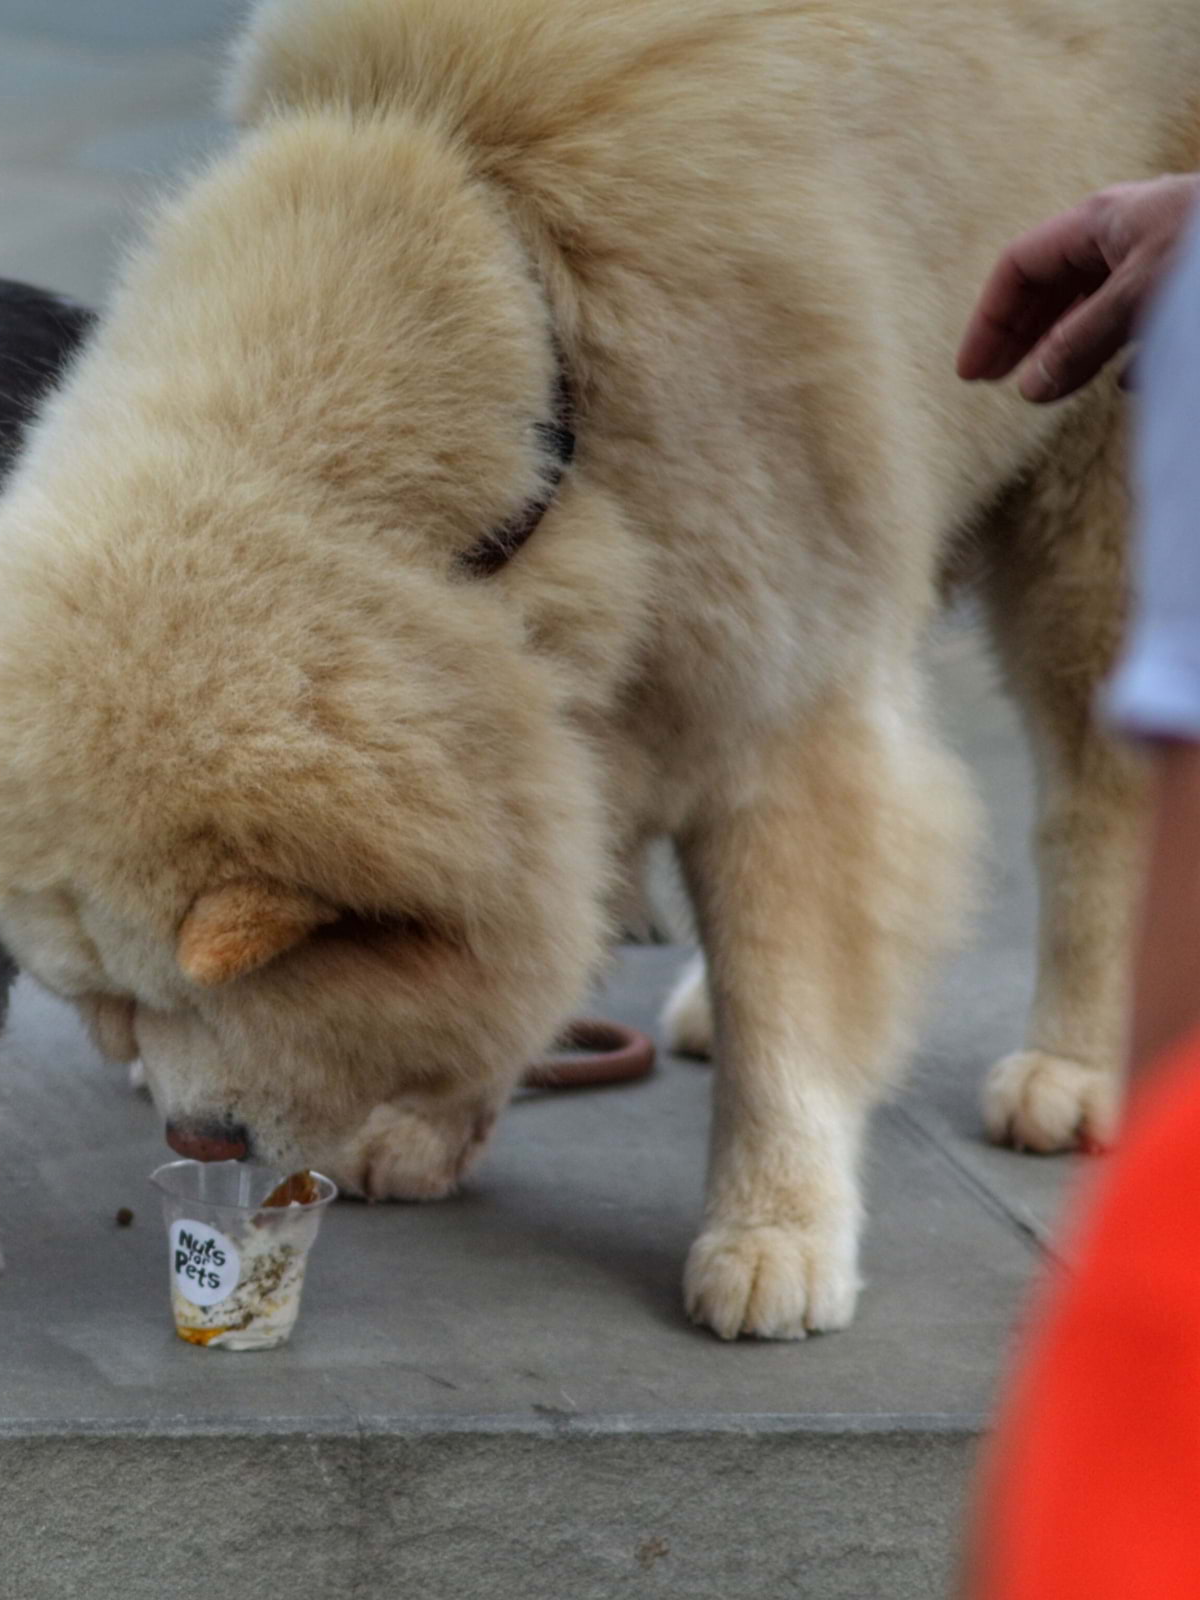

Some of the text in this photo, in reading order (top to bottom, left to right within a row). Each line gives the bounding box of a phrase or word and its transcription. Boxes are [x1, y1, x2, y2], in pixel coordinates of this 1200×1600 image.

[179, 1229, 226, 1267] Nuts
[188, 1250, 211, 1266] for
[175, 1249, 221, 1289] Pets
